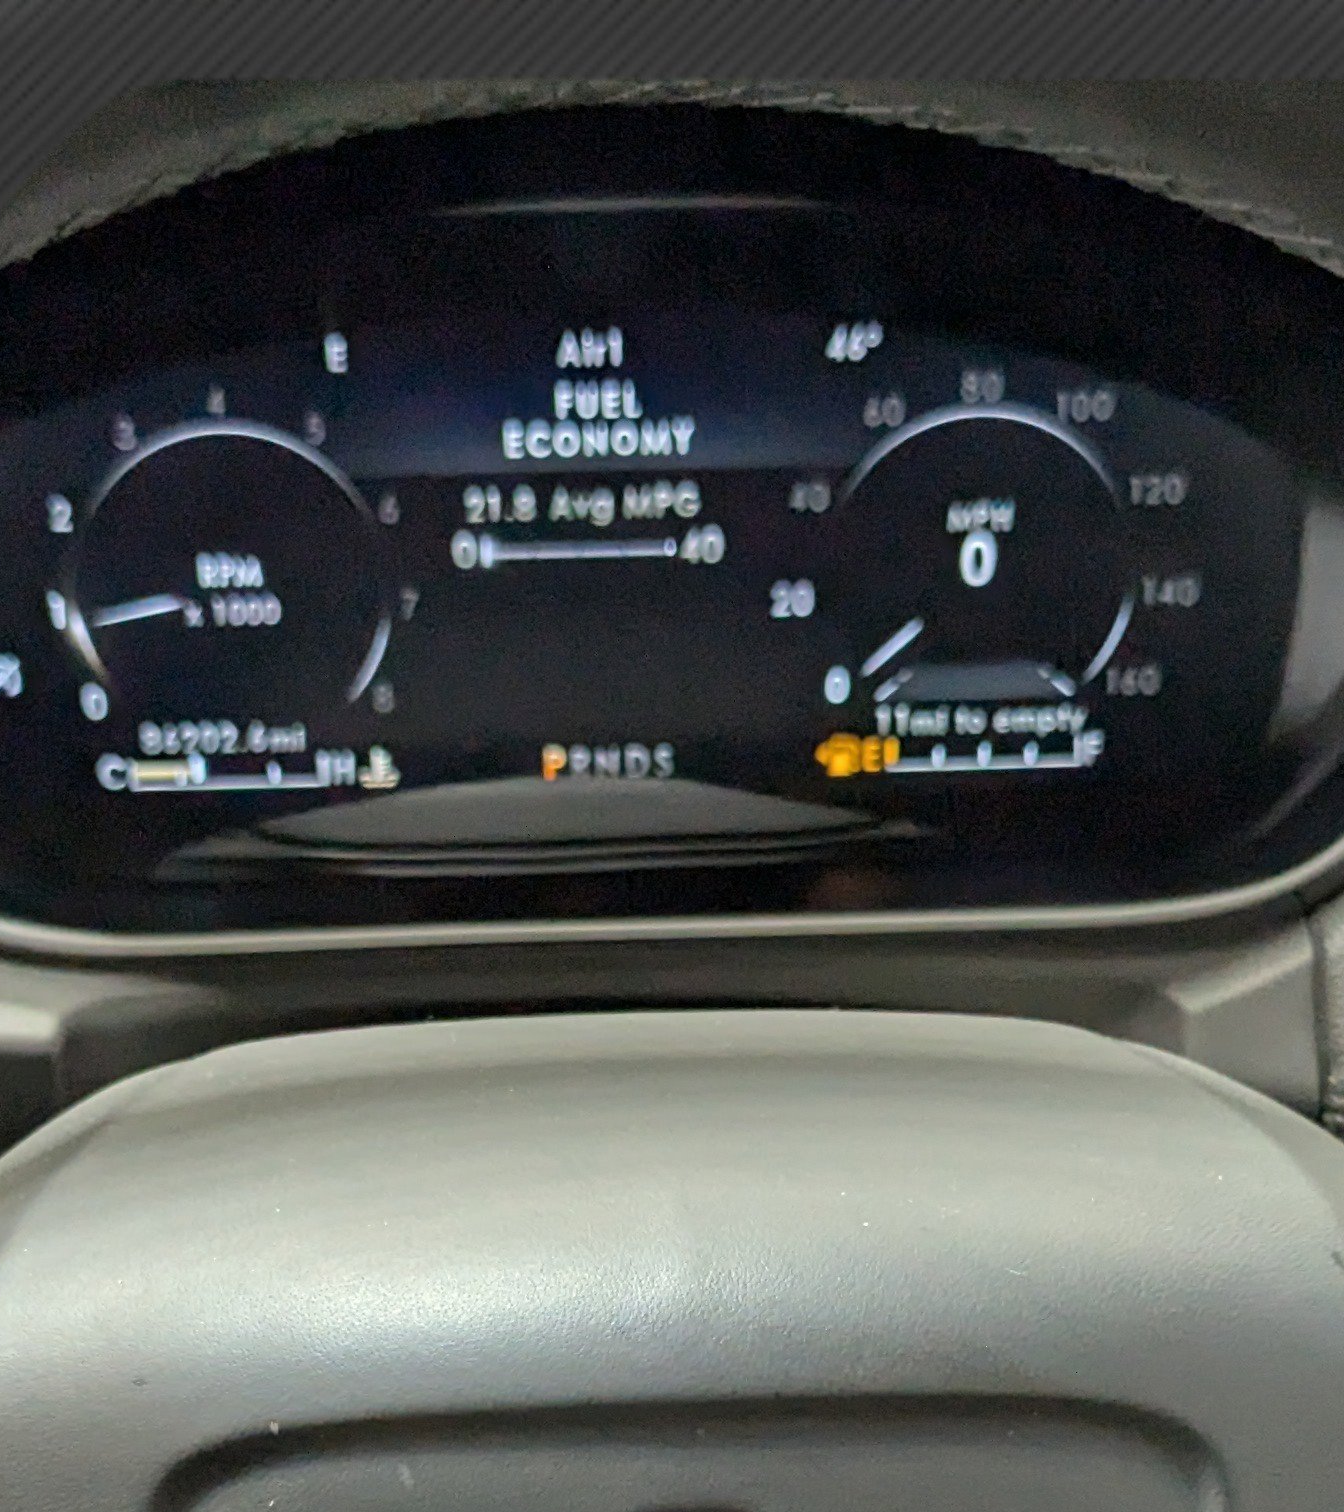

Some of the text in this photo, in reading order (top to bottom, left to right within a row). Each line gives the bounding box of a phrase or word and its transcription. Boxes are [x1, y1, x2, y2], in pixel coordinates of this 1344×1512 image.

[555, 378, 643, 420] FUEL
[960, 370, 1005, 402] 80
[502, 417, 696, 459] ECONOMY
[47, 495, 73, 532] 2
[550, 484, 614, 527] Avg
[623, 479, 702, 520] MPG
[452, 529, 478, 569] 0
[680, 523, 726, 565] 40
[960, 530, 997, 587] 0
[211, 593, 282, 627] 1000
[770, 579, 815, 618] 20
[79, 681, 108, 721] 0
[824, 666, 851, 705] 0
[993, 702, 1090, 738] empty
[96, 753, 129, 791] C
